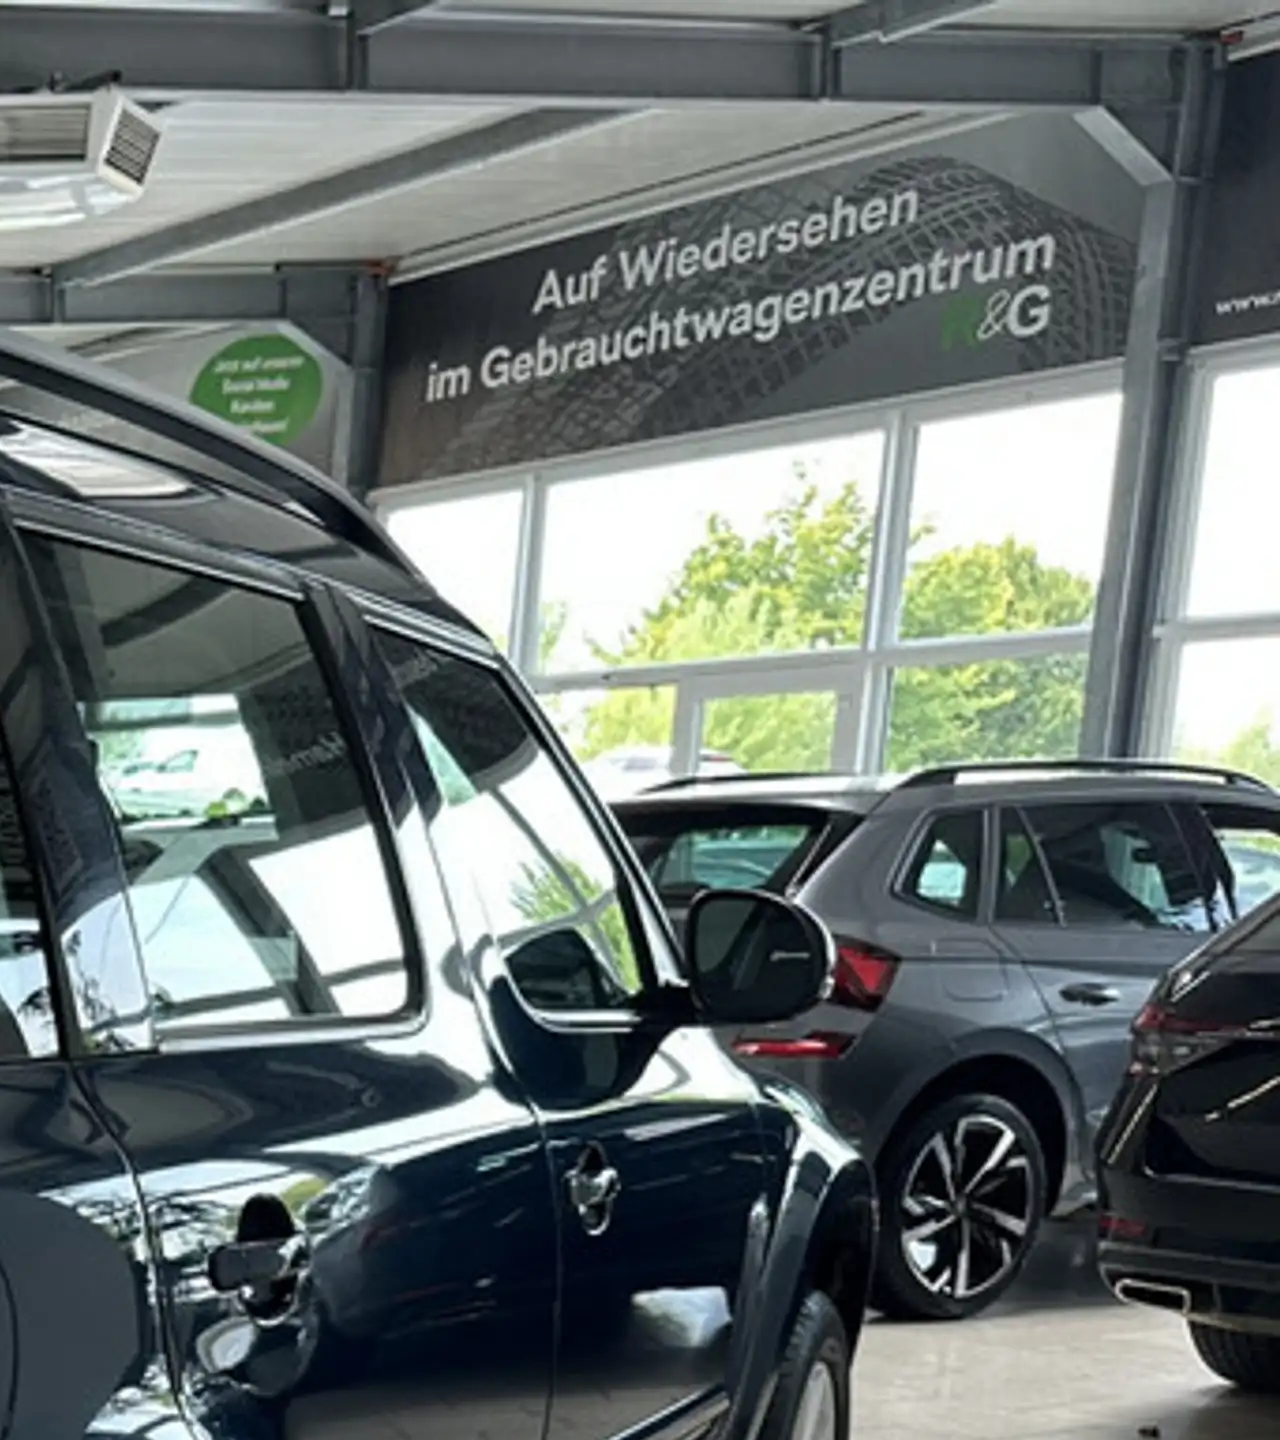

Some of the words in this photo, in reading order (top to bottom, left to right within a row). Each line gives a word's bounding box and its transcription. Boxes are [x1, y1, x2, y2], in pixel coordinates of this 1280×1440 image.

[425, 360, 472, 403] im
[479, 232, 1056, 390] Gebrauchtwagenzentrum
[531, 253, 609, 316] Auf
[619, 189, 919, 292] Wiedersehen
